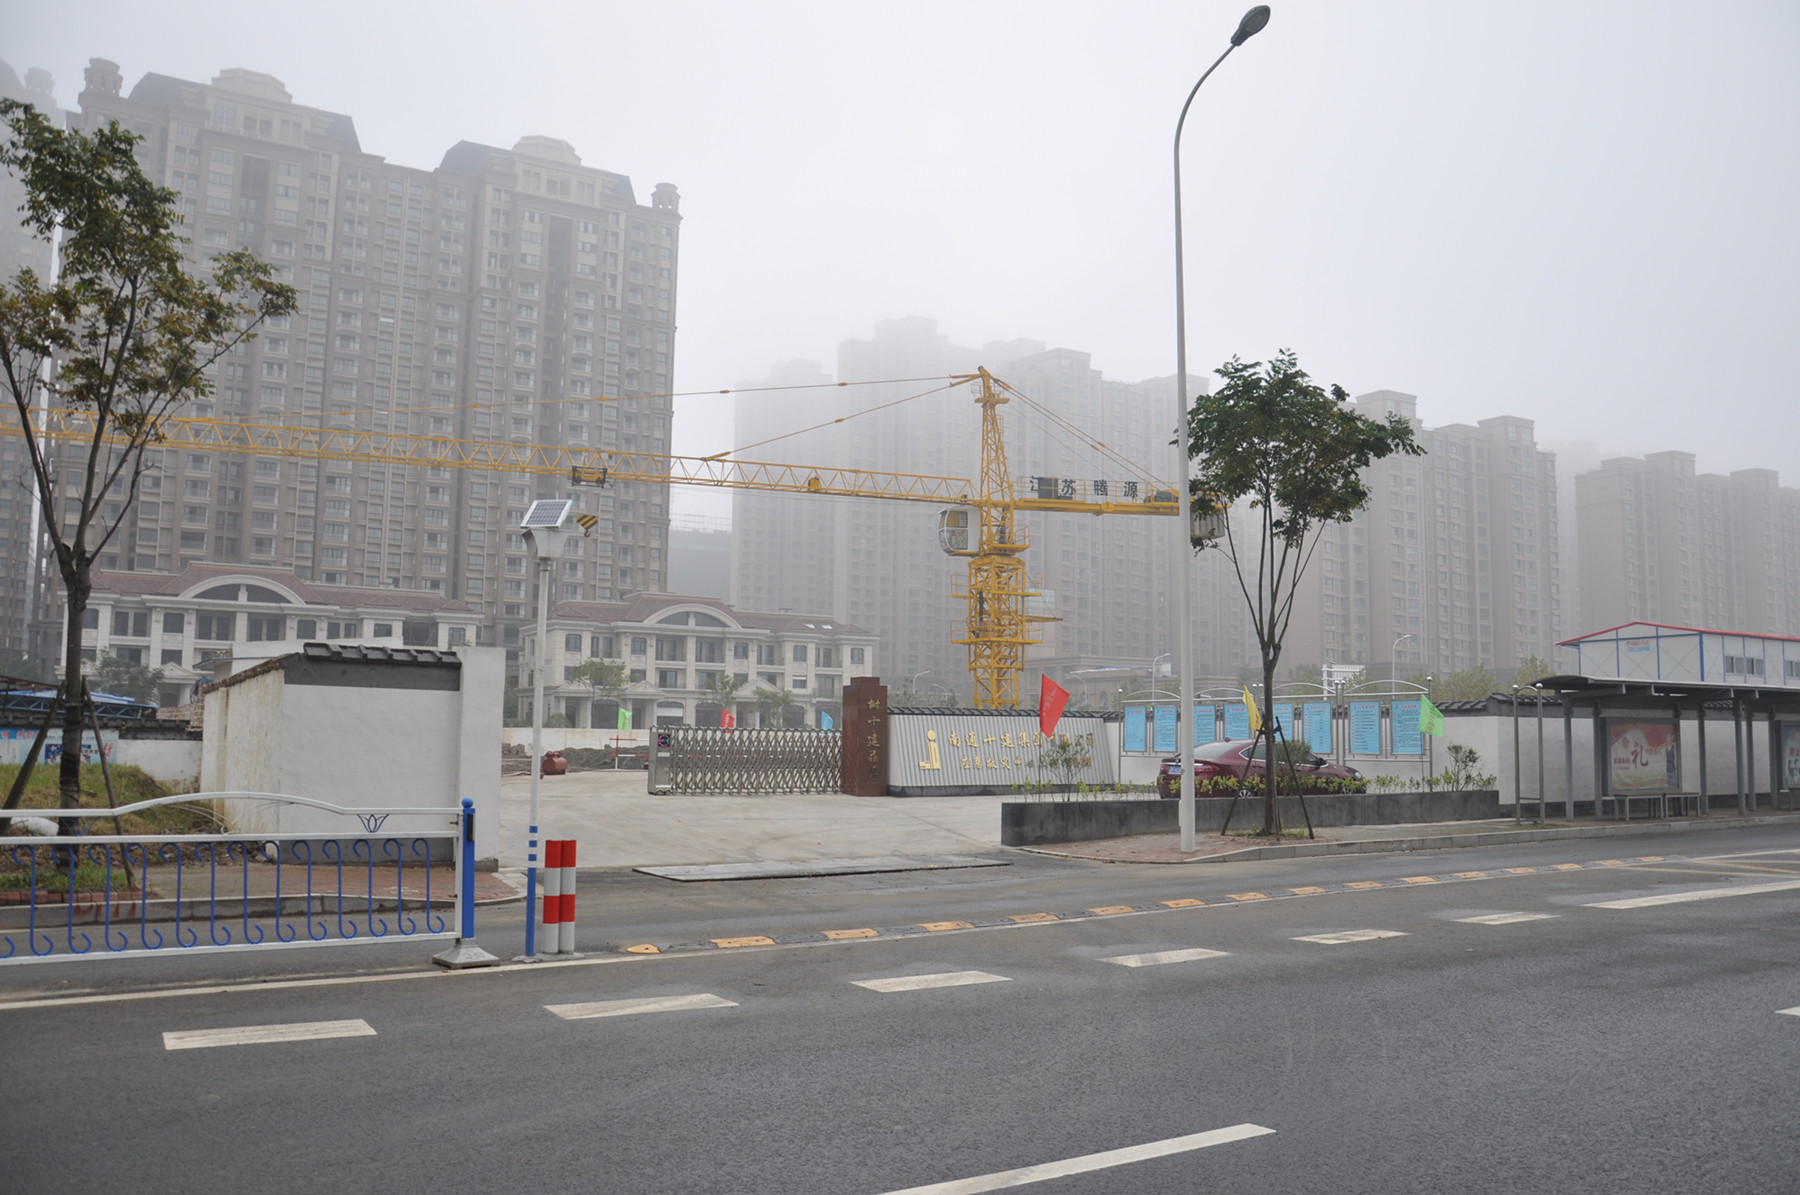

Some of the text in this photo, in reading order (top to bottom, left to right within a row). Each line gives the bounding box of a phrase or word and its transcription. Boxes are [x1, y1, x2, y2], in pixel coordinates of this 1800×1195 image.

[949, 730, 1095, 748] 南通十建集团限公司
[960, 754, 1092, 770] 应急救灾中心
